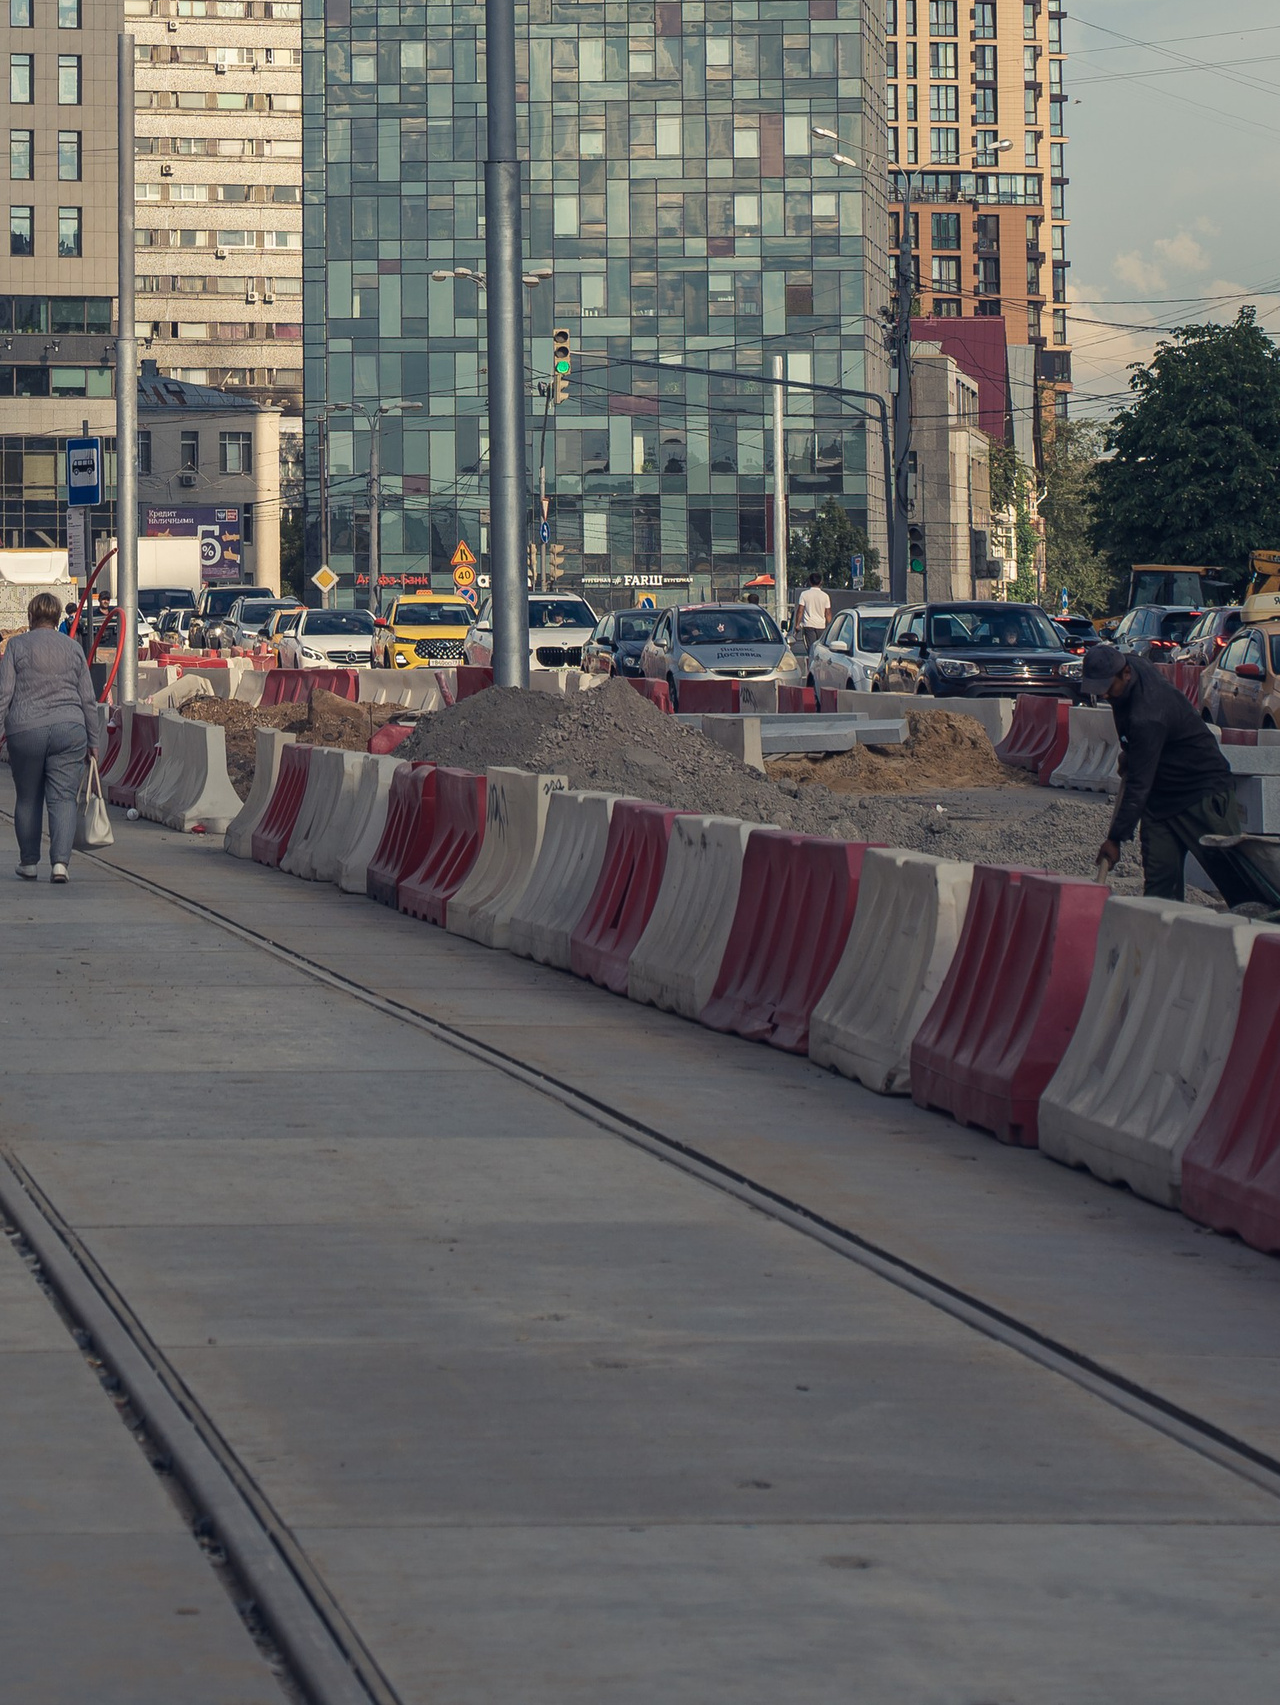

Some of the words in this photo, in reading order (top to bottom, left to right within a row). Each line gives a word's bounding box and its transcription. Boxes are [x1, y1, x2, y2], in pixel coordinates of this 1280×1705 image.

[148, 509, 177, 518] Кредит
[356, 573, 429, 586] Афа-Банк
[458, 571, 471, 580] 40
[624, 575, 663, 586] FARШ
